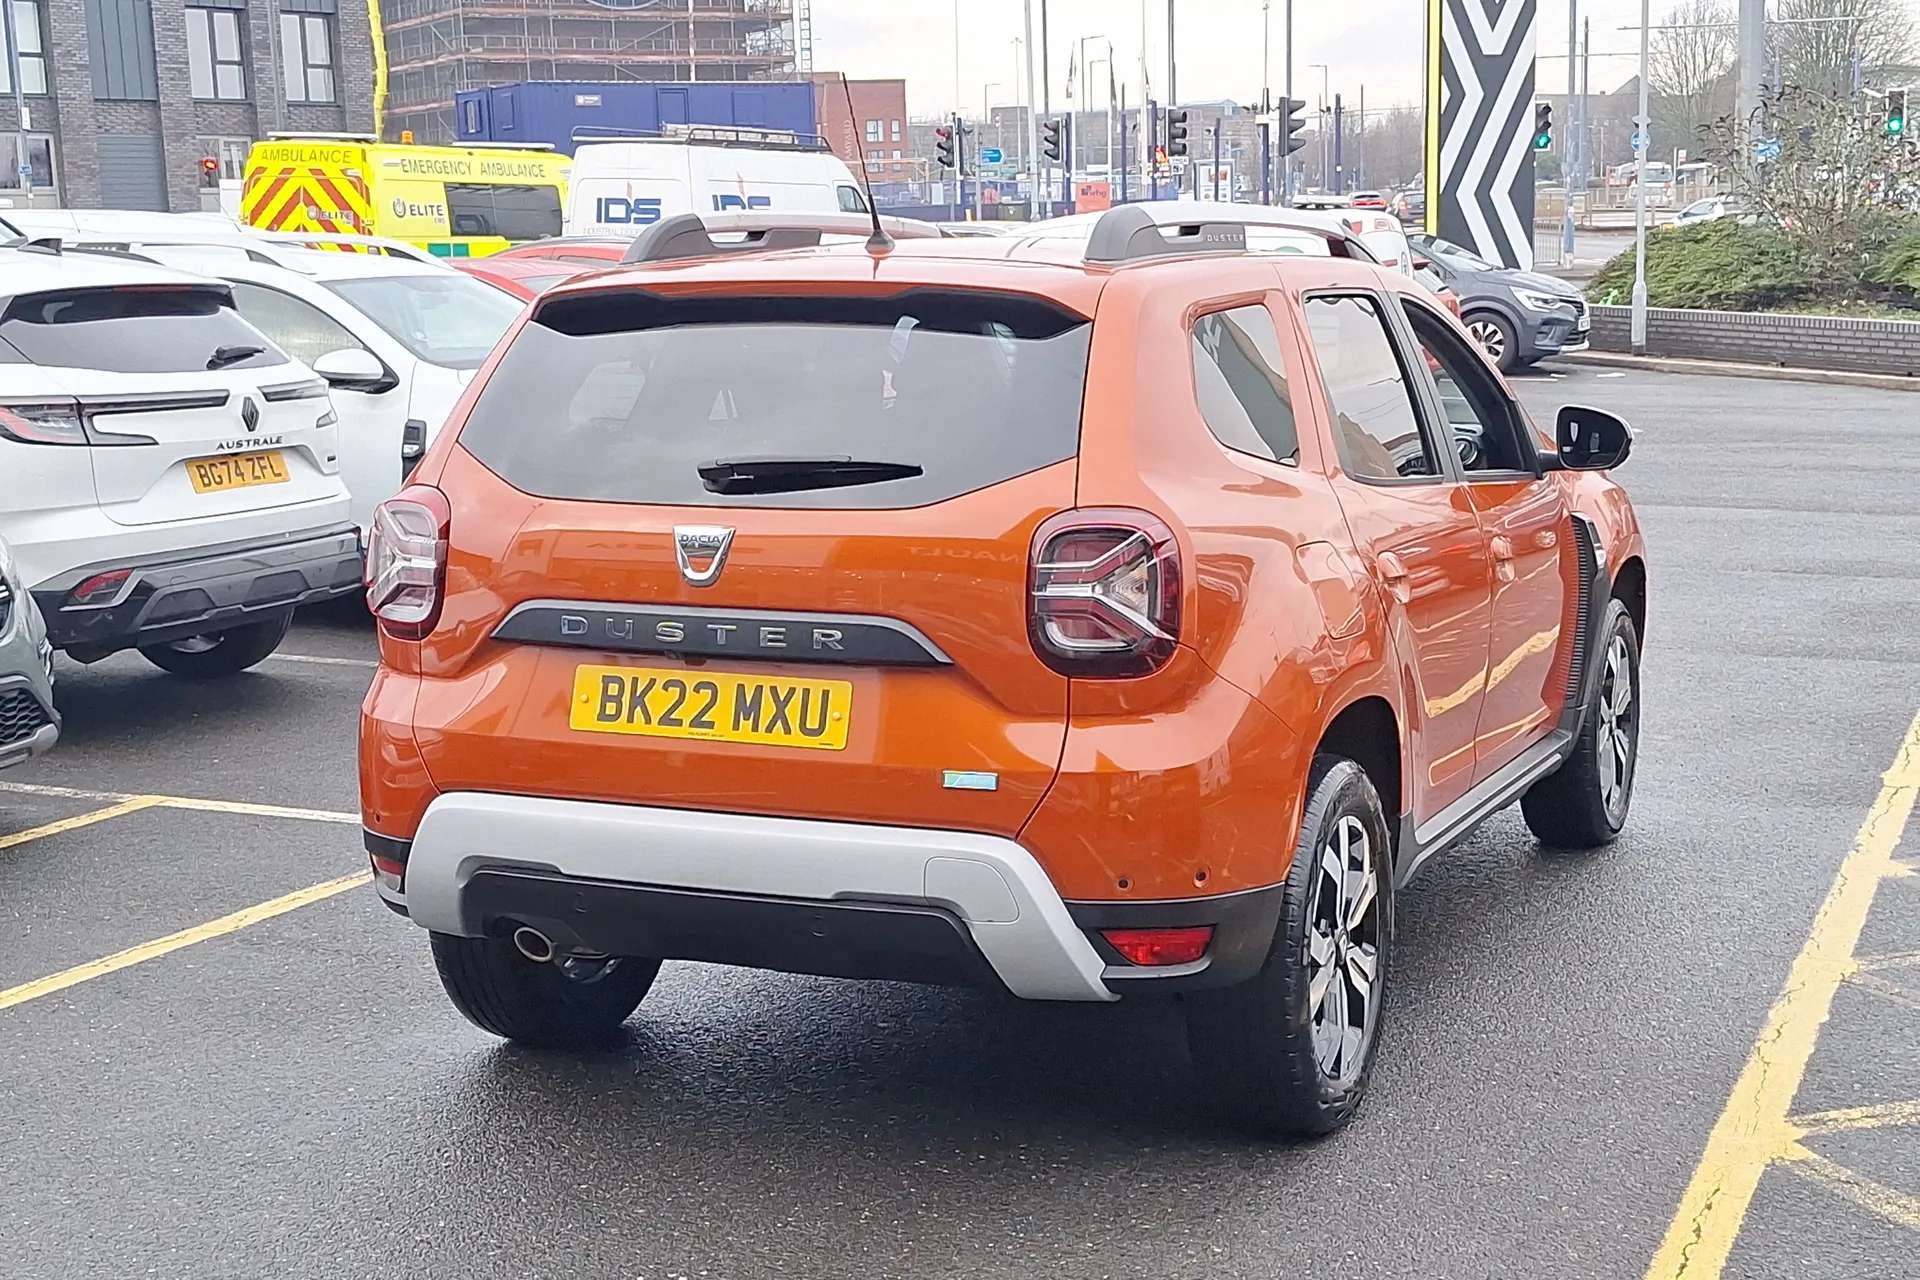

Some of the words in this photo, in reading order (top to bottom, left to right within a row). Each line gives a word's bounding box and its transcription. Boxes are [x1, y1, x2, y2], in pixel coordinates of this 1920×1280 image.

[261, 148, 353, 164] AMBULANCE
[400, 158, 473, 176] EMERGENCY
[479, 161, 547, 178] AMBULANCE
[320, 209, 353, 221] ELITE
[409, 204, 444, 217] ELITE
[596, 197, 662, 225] IDS
[1206, 233, 1244, 242] DUSTER
[216, 435, 283, 450] AUSTRALE
[195, 459, 246, 488] BG74
[245, 455, 282, 480] ZFL
[679, 534, 721, 544] DACIA
[560, 615, 845, 650] DUSTER
[597, 674, 719, 730] BK22
[732, 683, 830, 737] MXU
